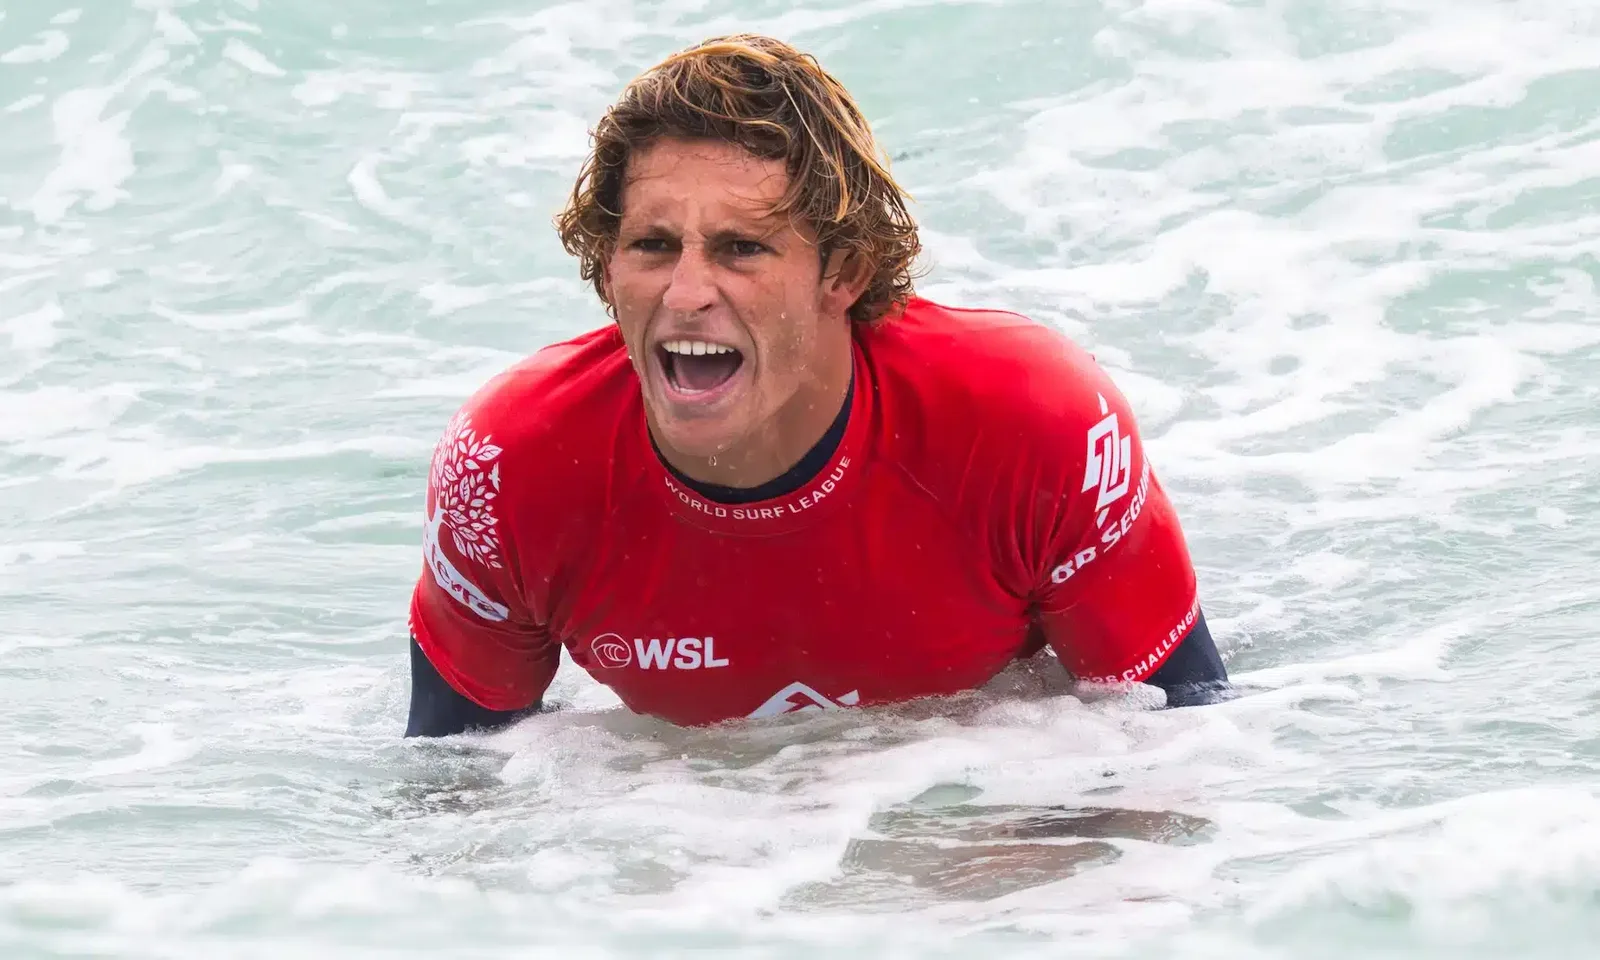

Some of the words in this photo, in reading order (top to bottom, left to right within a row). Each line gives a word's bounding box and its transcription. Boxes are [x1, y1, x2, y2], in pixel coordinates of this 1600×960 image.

[664, 476, 727, 518] WORLD
[732, 506, 785, 520] SURF
[790, 455, 851, 514] LEAGUE
[633, 636, 730, 670] WSL
